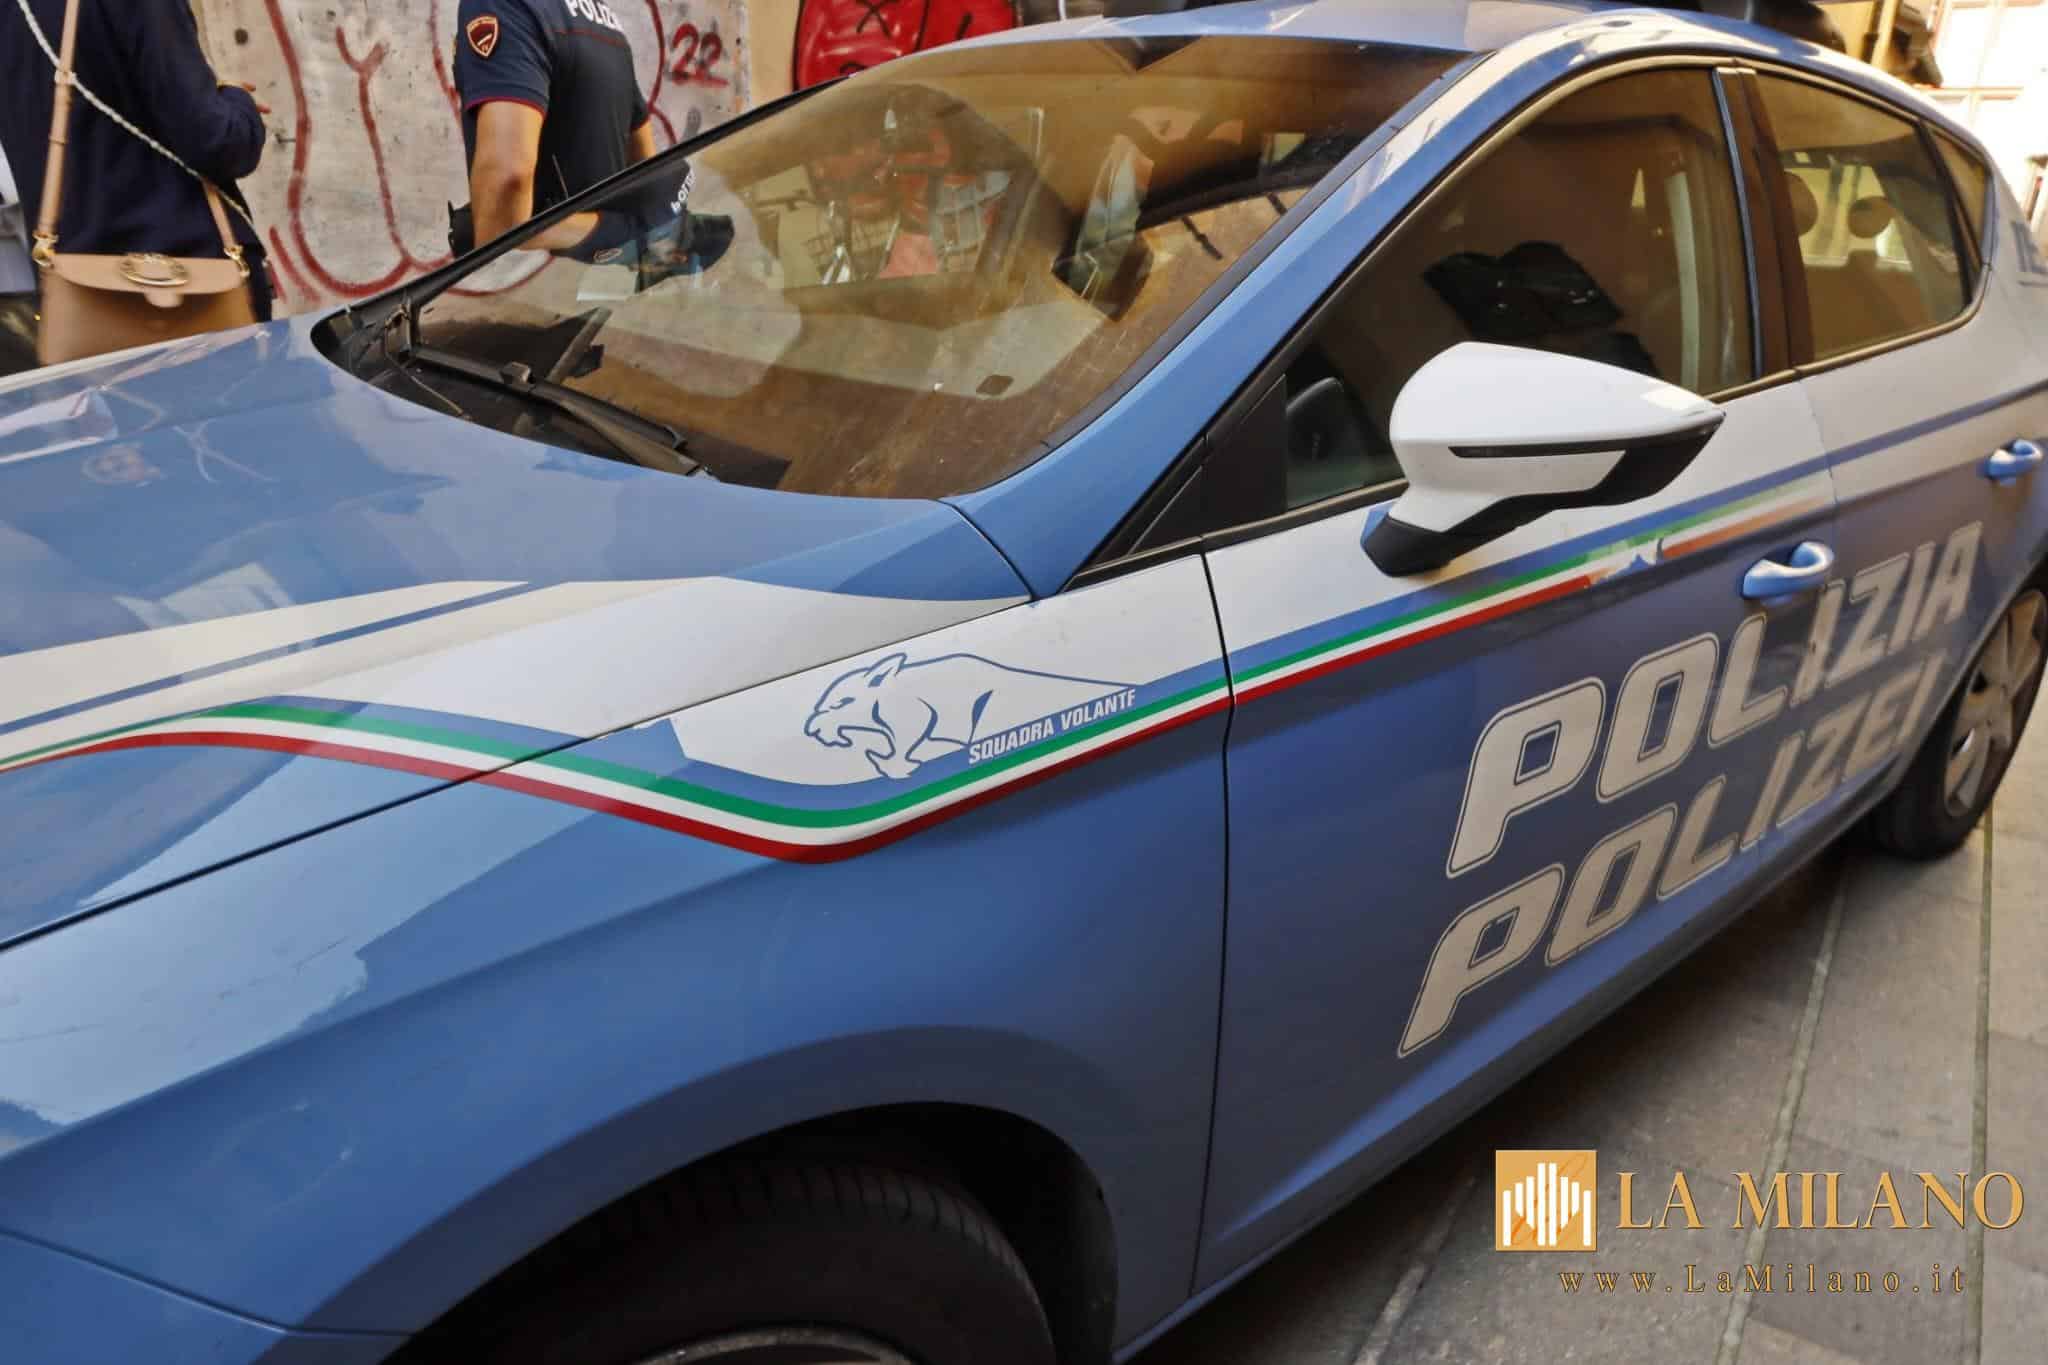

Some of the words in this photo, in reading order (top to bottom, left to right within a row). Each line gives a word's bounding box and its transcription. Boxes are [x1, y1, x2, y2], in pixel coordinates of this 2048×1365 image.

[968, 718, 1055, 765] SQUADRA
[1397, 649, 1947, 1058] POLIZEI
[1446, 521, 1983, 878] POLIZIA
